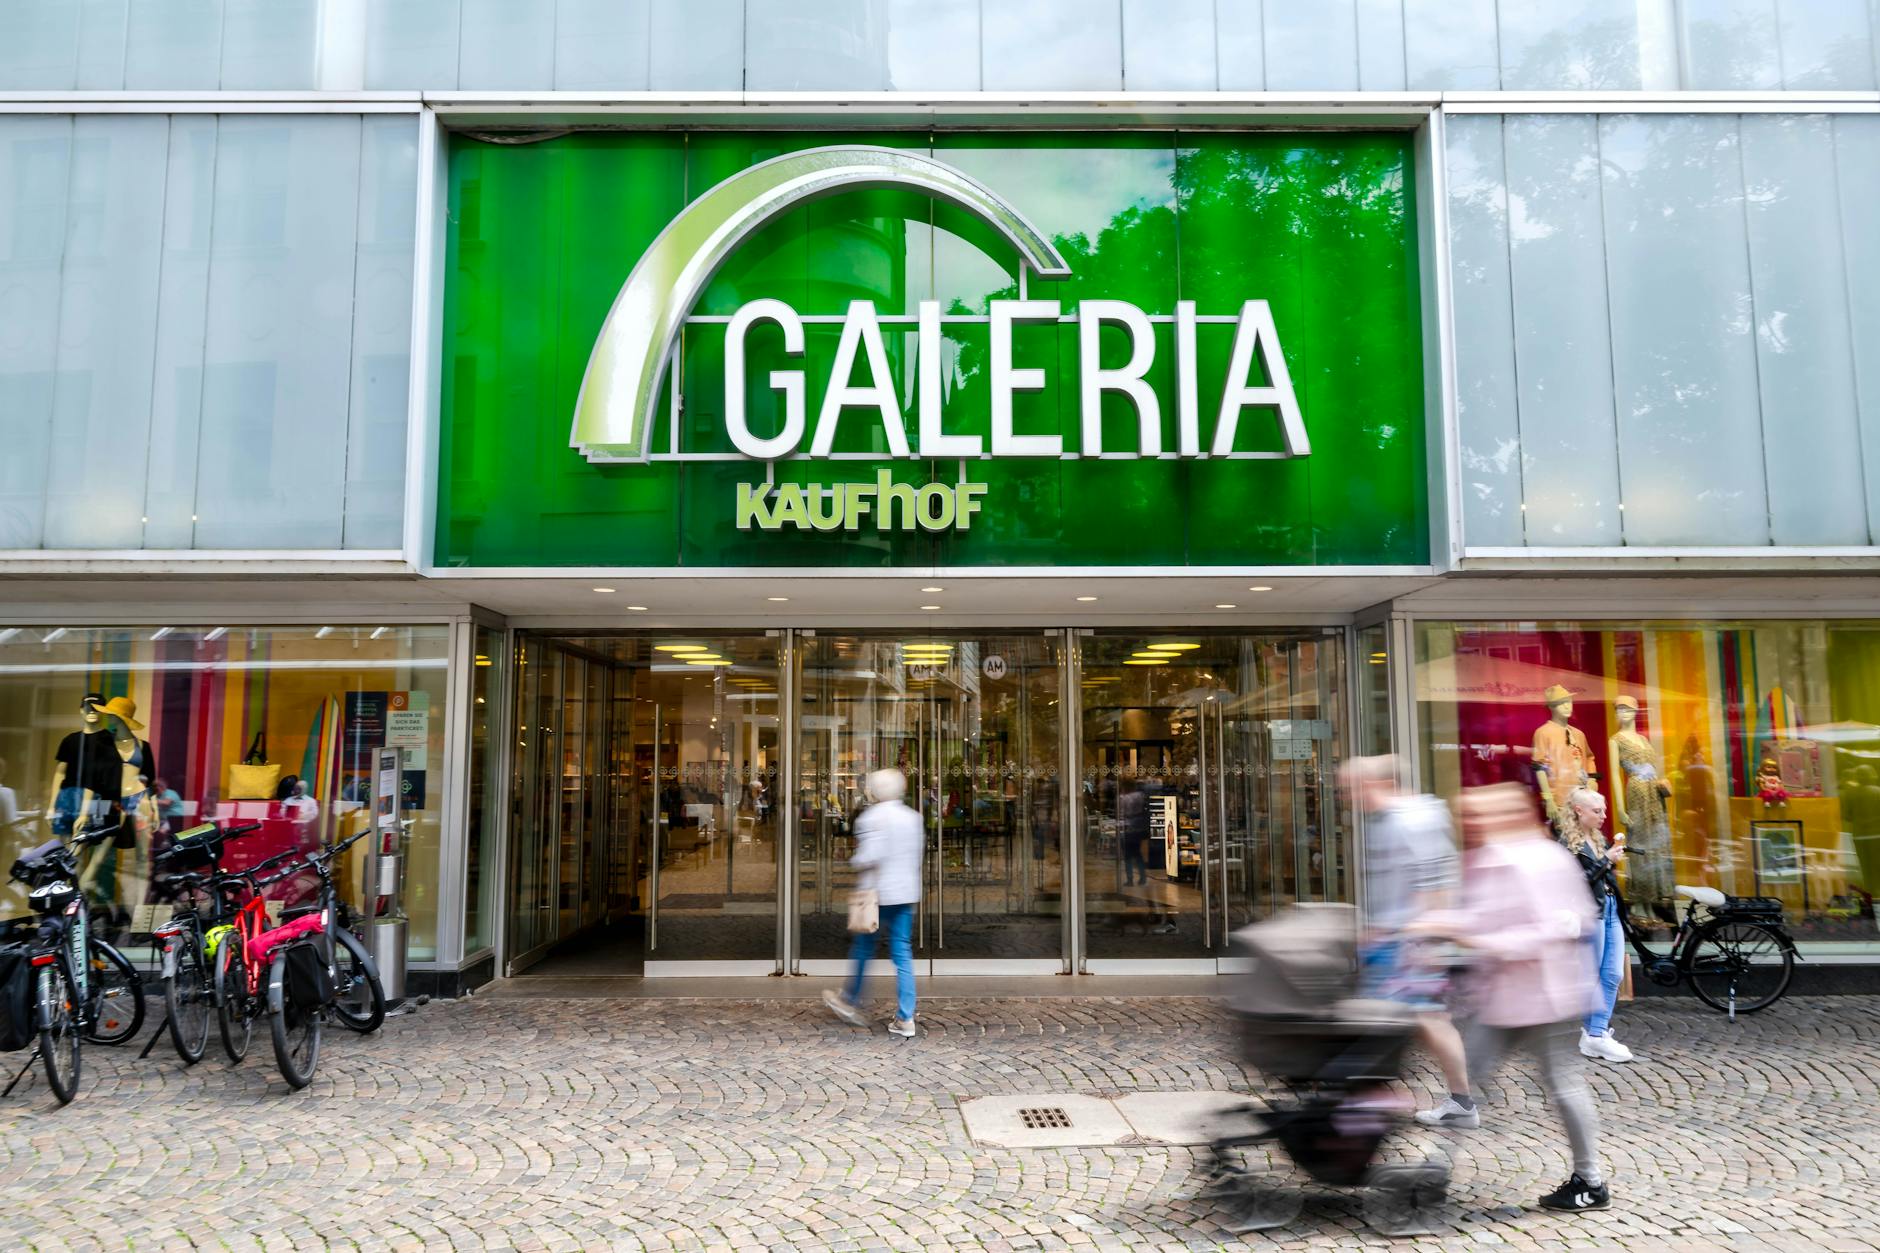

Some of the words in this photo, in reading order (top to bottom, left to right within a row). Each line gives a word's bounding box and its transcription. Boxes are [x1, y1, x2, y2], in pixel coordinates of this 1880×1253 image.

[724, 298, 1312, 460] GALERIA
[736, 468, 989, 533] KAUFhOF
[986, 661, 1003, 672] AM
